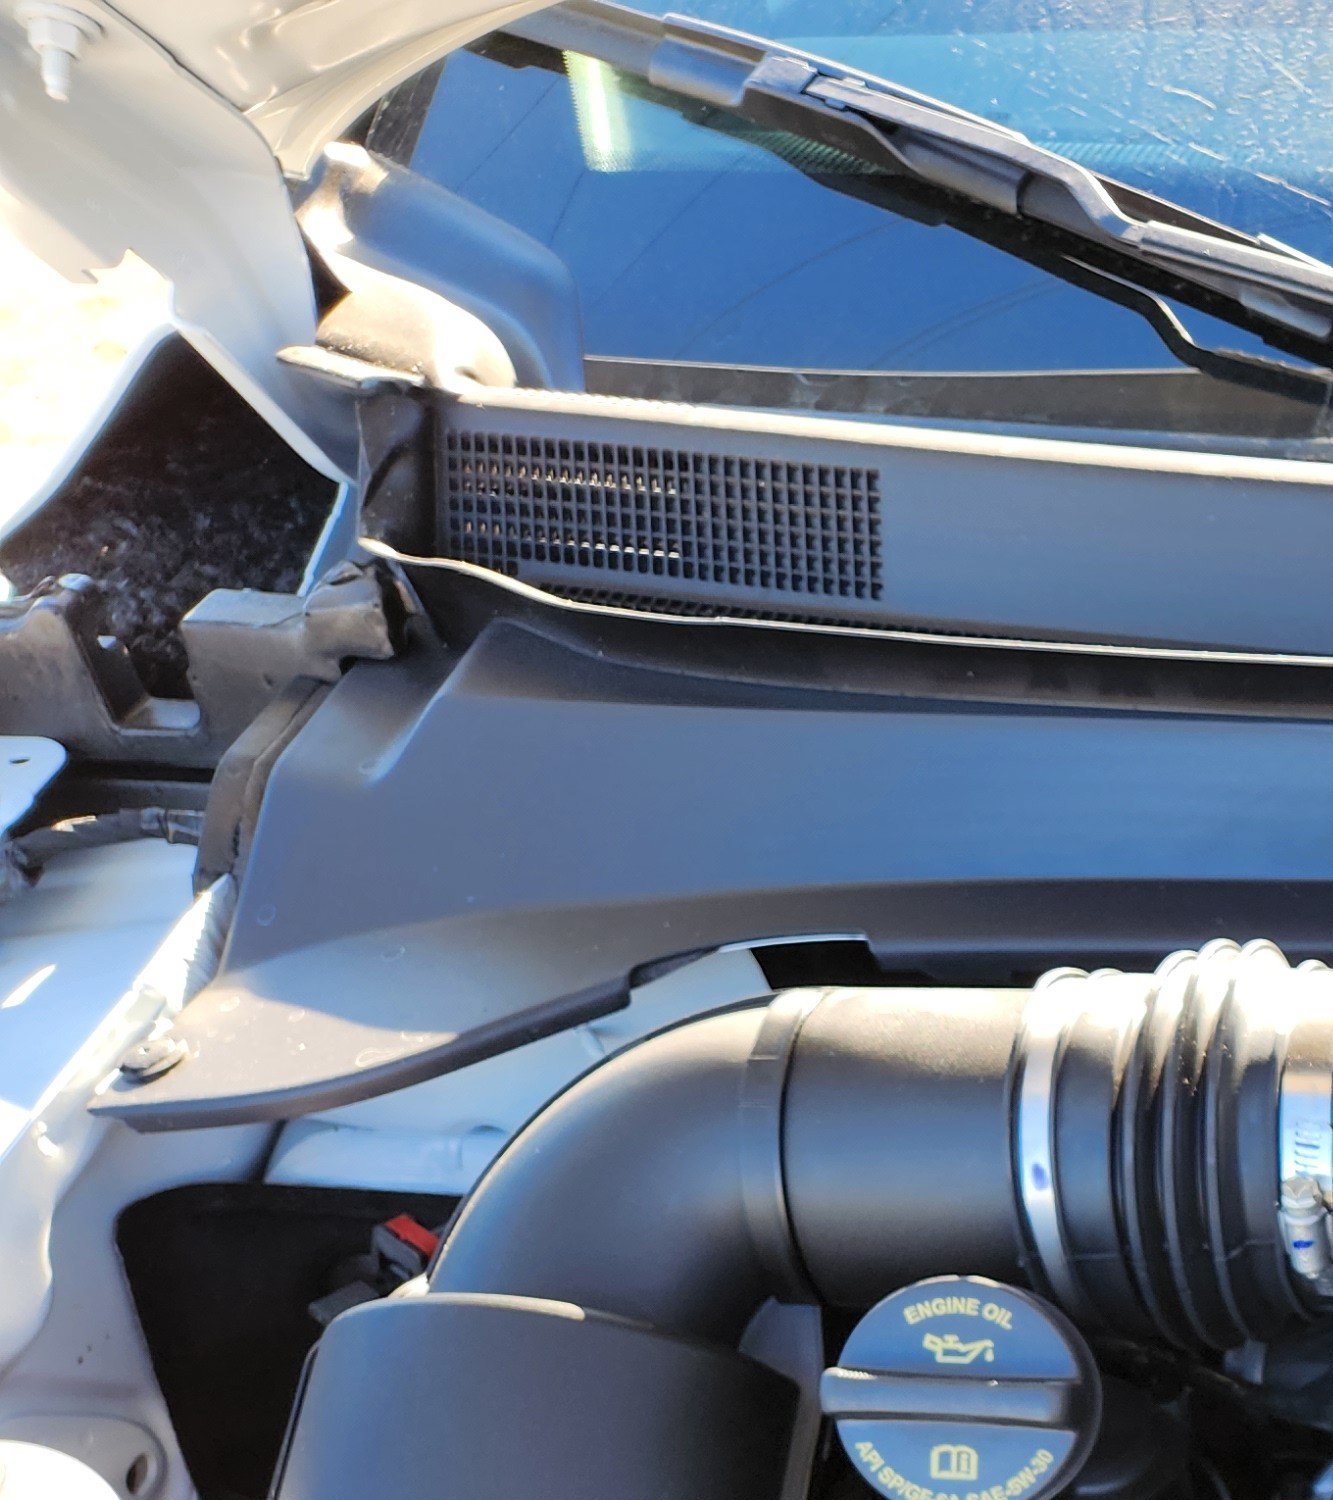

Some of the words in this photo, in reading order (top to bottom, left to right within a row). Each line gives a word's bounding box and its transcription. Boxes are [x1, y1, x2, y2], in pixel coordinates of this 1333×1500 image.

[903, 1296, 981, 1325] ENGINE
[981, 1302, 1013, 1330] OIL
[854, 1441, 885, 1473] API
